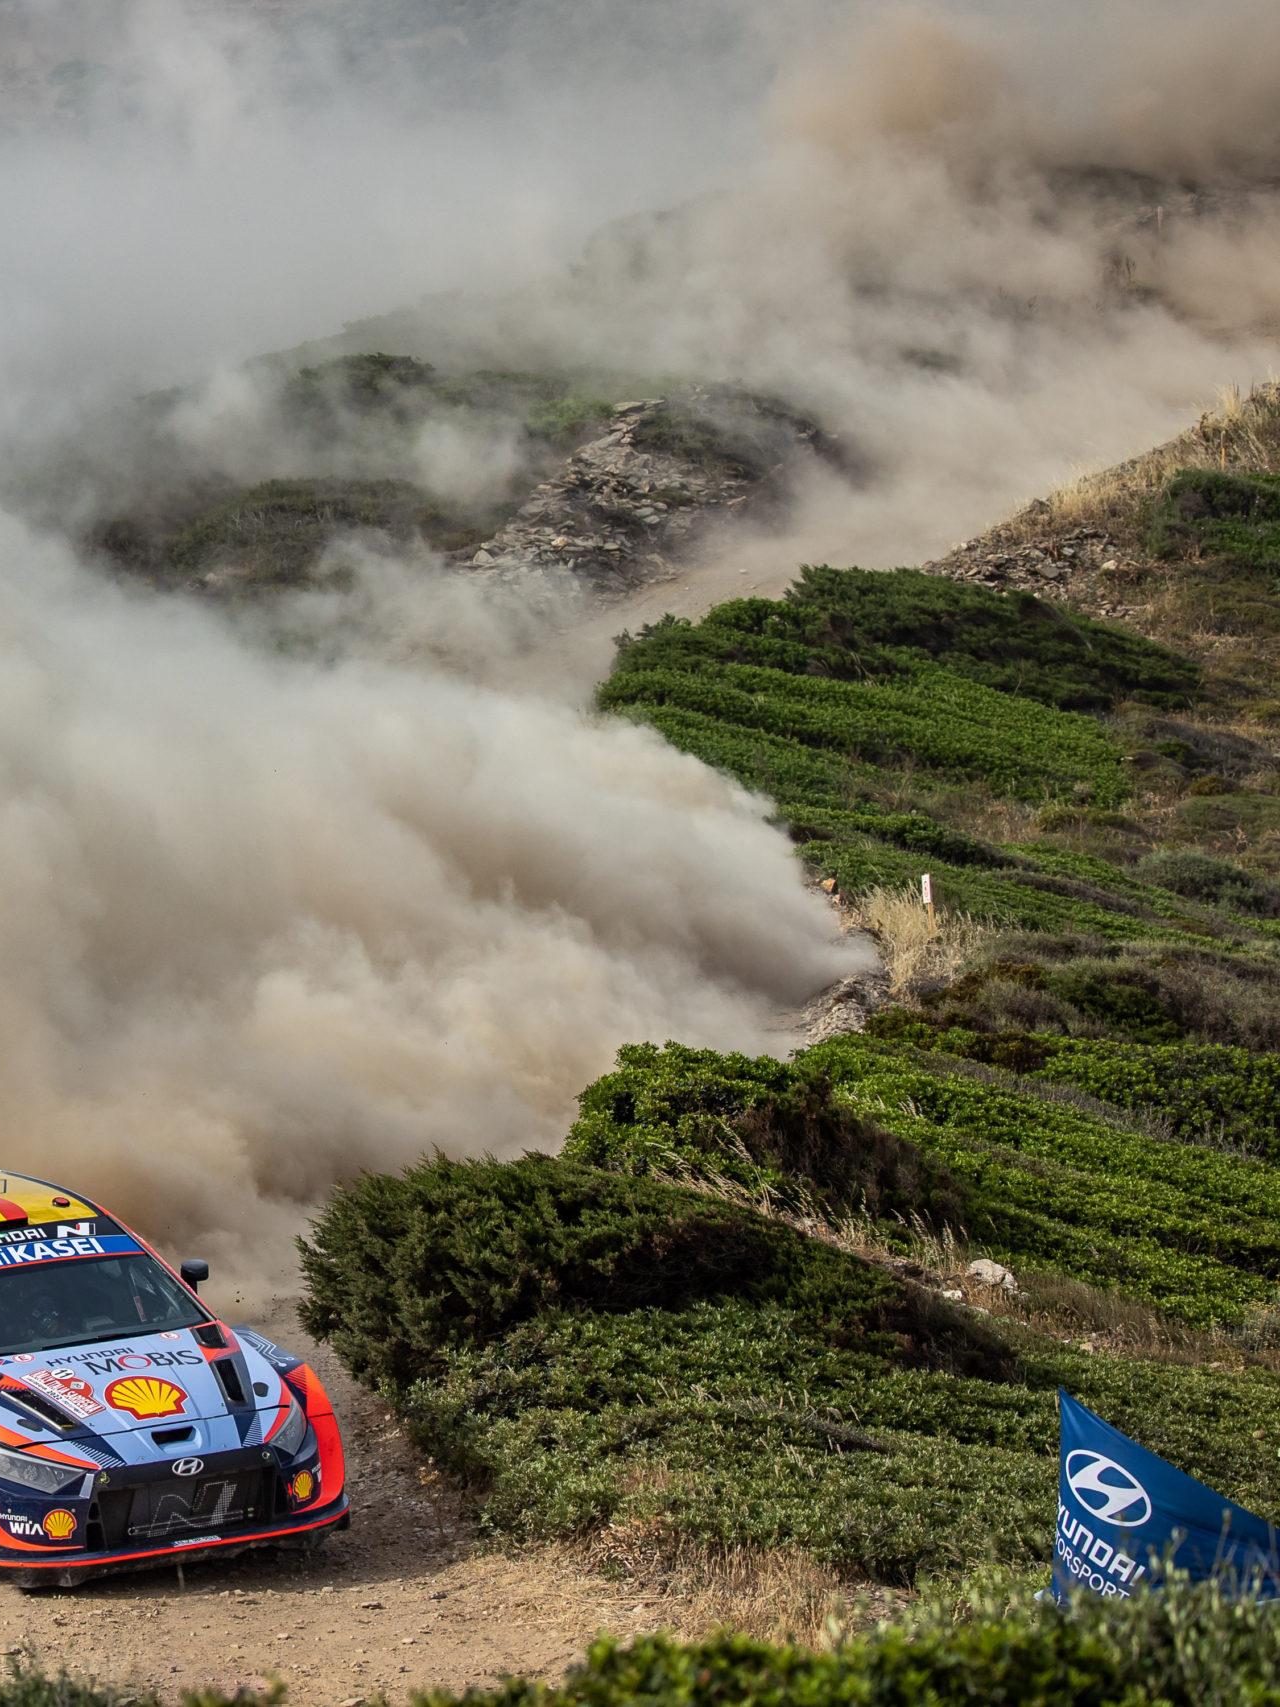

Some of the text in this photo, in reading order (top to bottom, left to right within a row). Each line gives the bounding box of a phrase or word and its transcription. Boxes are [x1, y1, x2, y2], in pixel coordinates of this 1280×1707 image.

[46, 1347, 136, 1367] HYUNDAI
[83, 1350, 204, 1376] MOBIS
[54, 1369, 73, 1379] 11
[0, 1513, 28, 1522] HYUNDAI
[9, 1520, 44, 1536] WIA
[1058, 1503, 1146, 1587] YUNDAI
